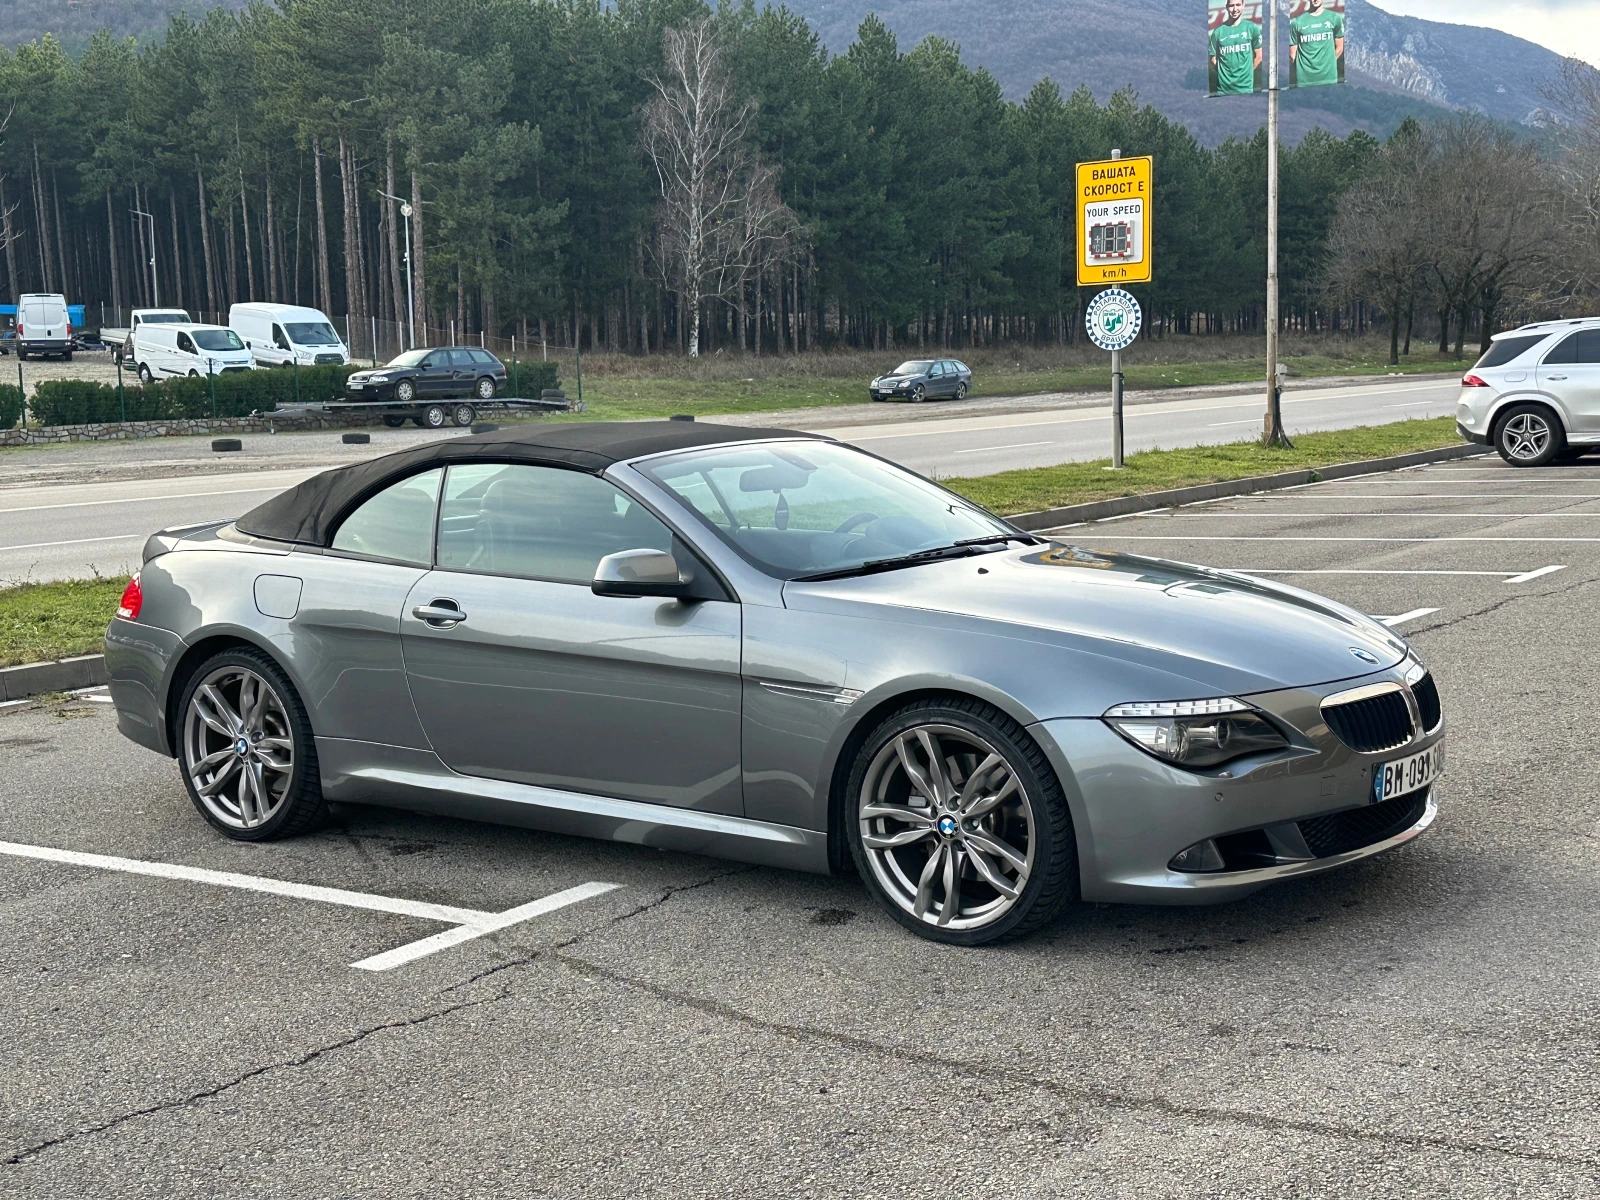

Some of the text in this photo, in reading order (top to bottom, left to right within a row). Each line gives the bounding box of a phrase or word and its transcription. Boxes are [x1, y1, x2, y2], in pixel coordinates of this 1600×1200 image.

[1300, 31, 1332, 43] WINBET
[1219, 42, 1251, 55] WINBET
[1092, 166, 1136, 180] ВАШАТА
[1084, 181, 1144, 197] СКОРОСТ Е
[1087, 204, 1141, 218] YOUR SPEED
[1102, 267, 1127, 278] km/h
[1093, 296, 1117, 316] РОТАРИ
